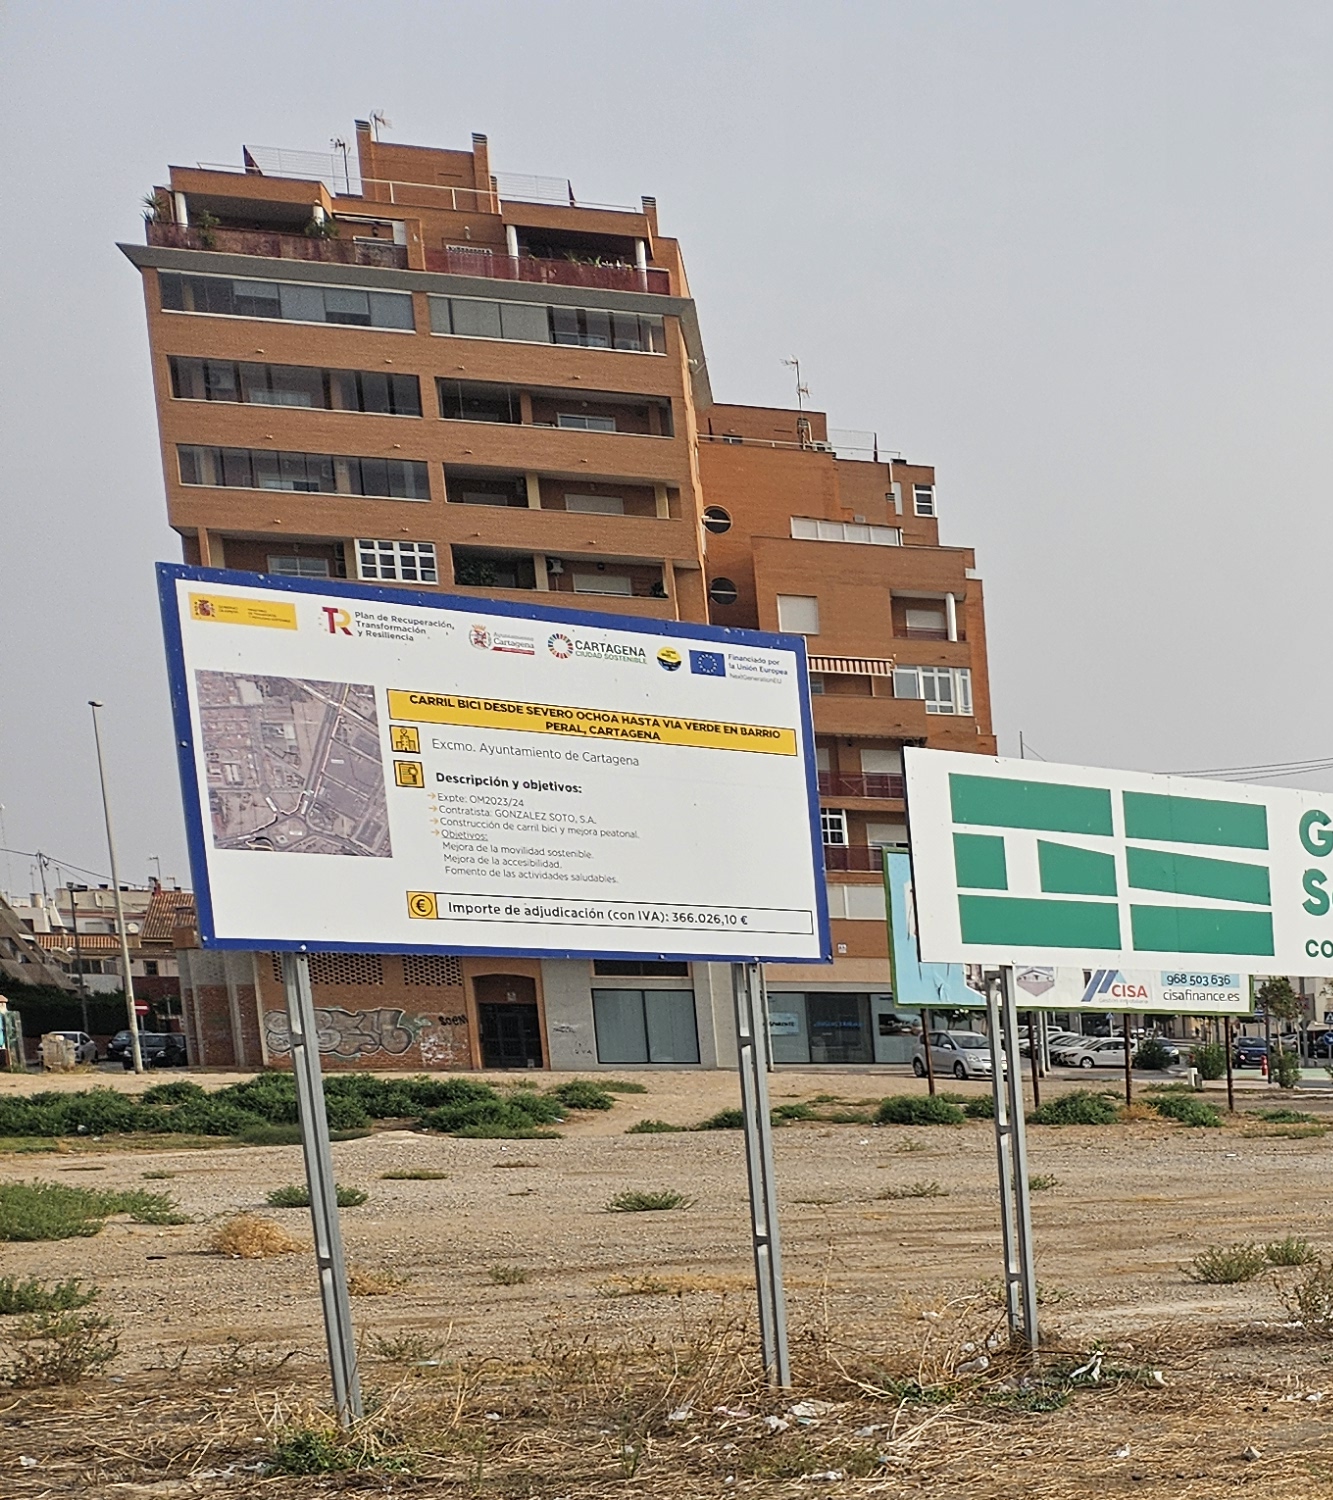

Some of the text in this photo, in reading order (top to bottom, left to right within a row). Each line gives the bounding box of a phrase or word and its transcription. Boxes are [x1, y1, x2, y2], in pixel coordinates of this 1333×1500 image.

[355, 612, 455, 630] Plan de Recuperación,
[356, 621, 427, 634] Transformación
[365, 630, 414, 642] Resiliencia
[494, 638, 534, 649] Cartagena
[575, 640, 646, 657] CARTAGENA
[575, 651, 603, 660] CIUDAD
[604, 654, 648, 665] SOSTENIBLE
[728, 654, 780, 668] Financiado por
[737, 663, 757, 673] Unión
[760, 667, 788, 677] Europea
[409, 694, 781, 740] CARRIL BICI DESDE SEVERO OCHOA HASTA VIA VERDE EN BARRIO
[545, 721, 661, 742] PERAL, CARTAGENA
[431, 738, 639, 768] Excmo. Ayuntamiento de Cartagena
[436, 772, 582, 794] Descripción y objetivos:
[437, 792, 524, 808] Expte: OM2023/24
[439, 805, 490, 818] Contratista:
[494, 808, 546, 821] GONZALEZ
[440, 817, 500, 830] Construcción
[502, 820, 514, 830] de
[516, 822, 539, 833] carril
[541, 823, 557, 833] bici
[559, 827, 565, 836] y
[567, 825, 598, 837] mejora
[441, 829, 488, 841] Objetivos:
[442, 842, 594, 860] Mejora de la movilidad sostenible.
[443, 853, 475, 866] Mejora
[477, 855, 490, 865] de
[491, 856, 500, 865] la
[445, 866, 487, 877] Fomento
[489, 867, 501, 877] de
[503, 868, 516, 878] las
[518, 869, 569, 881] actividades
[448, 902, 748, 926] Importe de adjudicación (con IVA): 366.026,10 €
[1166, 974, 1231, 986] 968 503 636
[1111, 984, 1148, 998] CISA
[1163, 989, 1240, 1002] cisafinance.es
